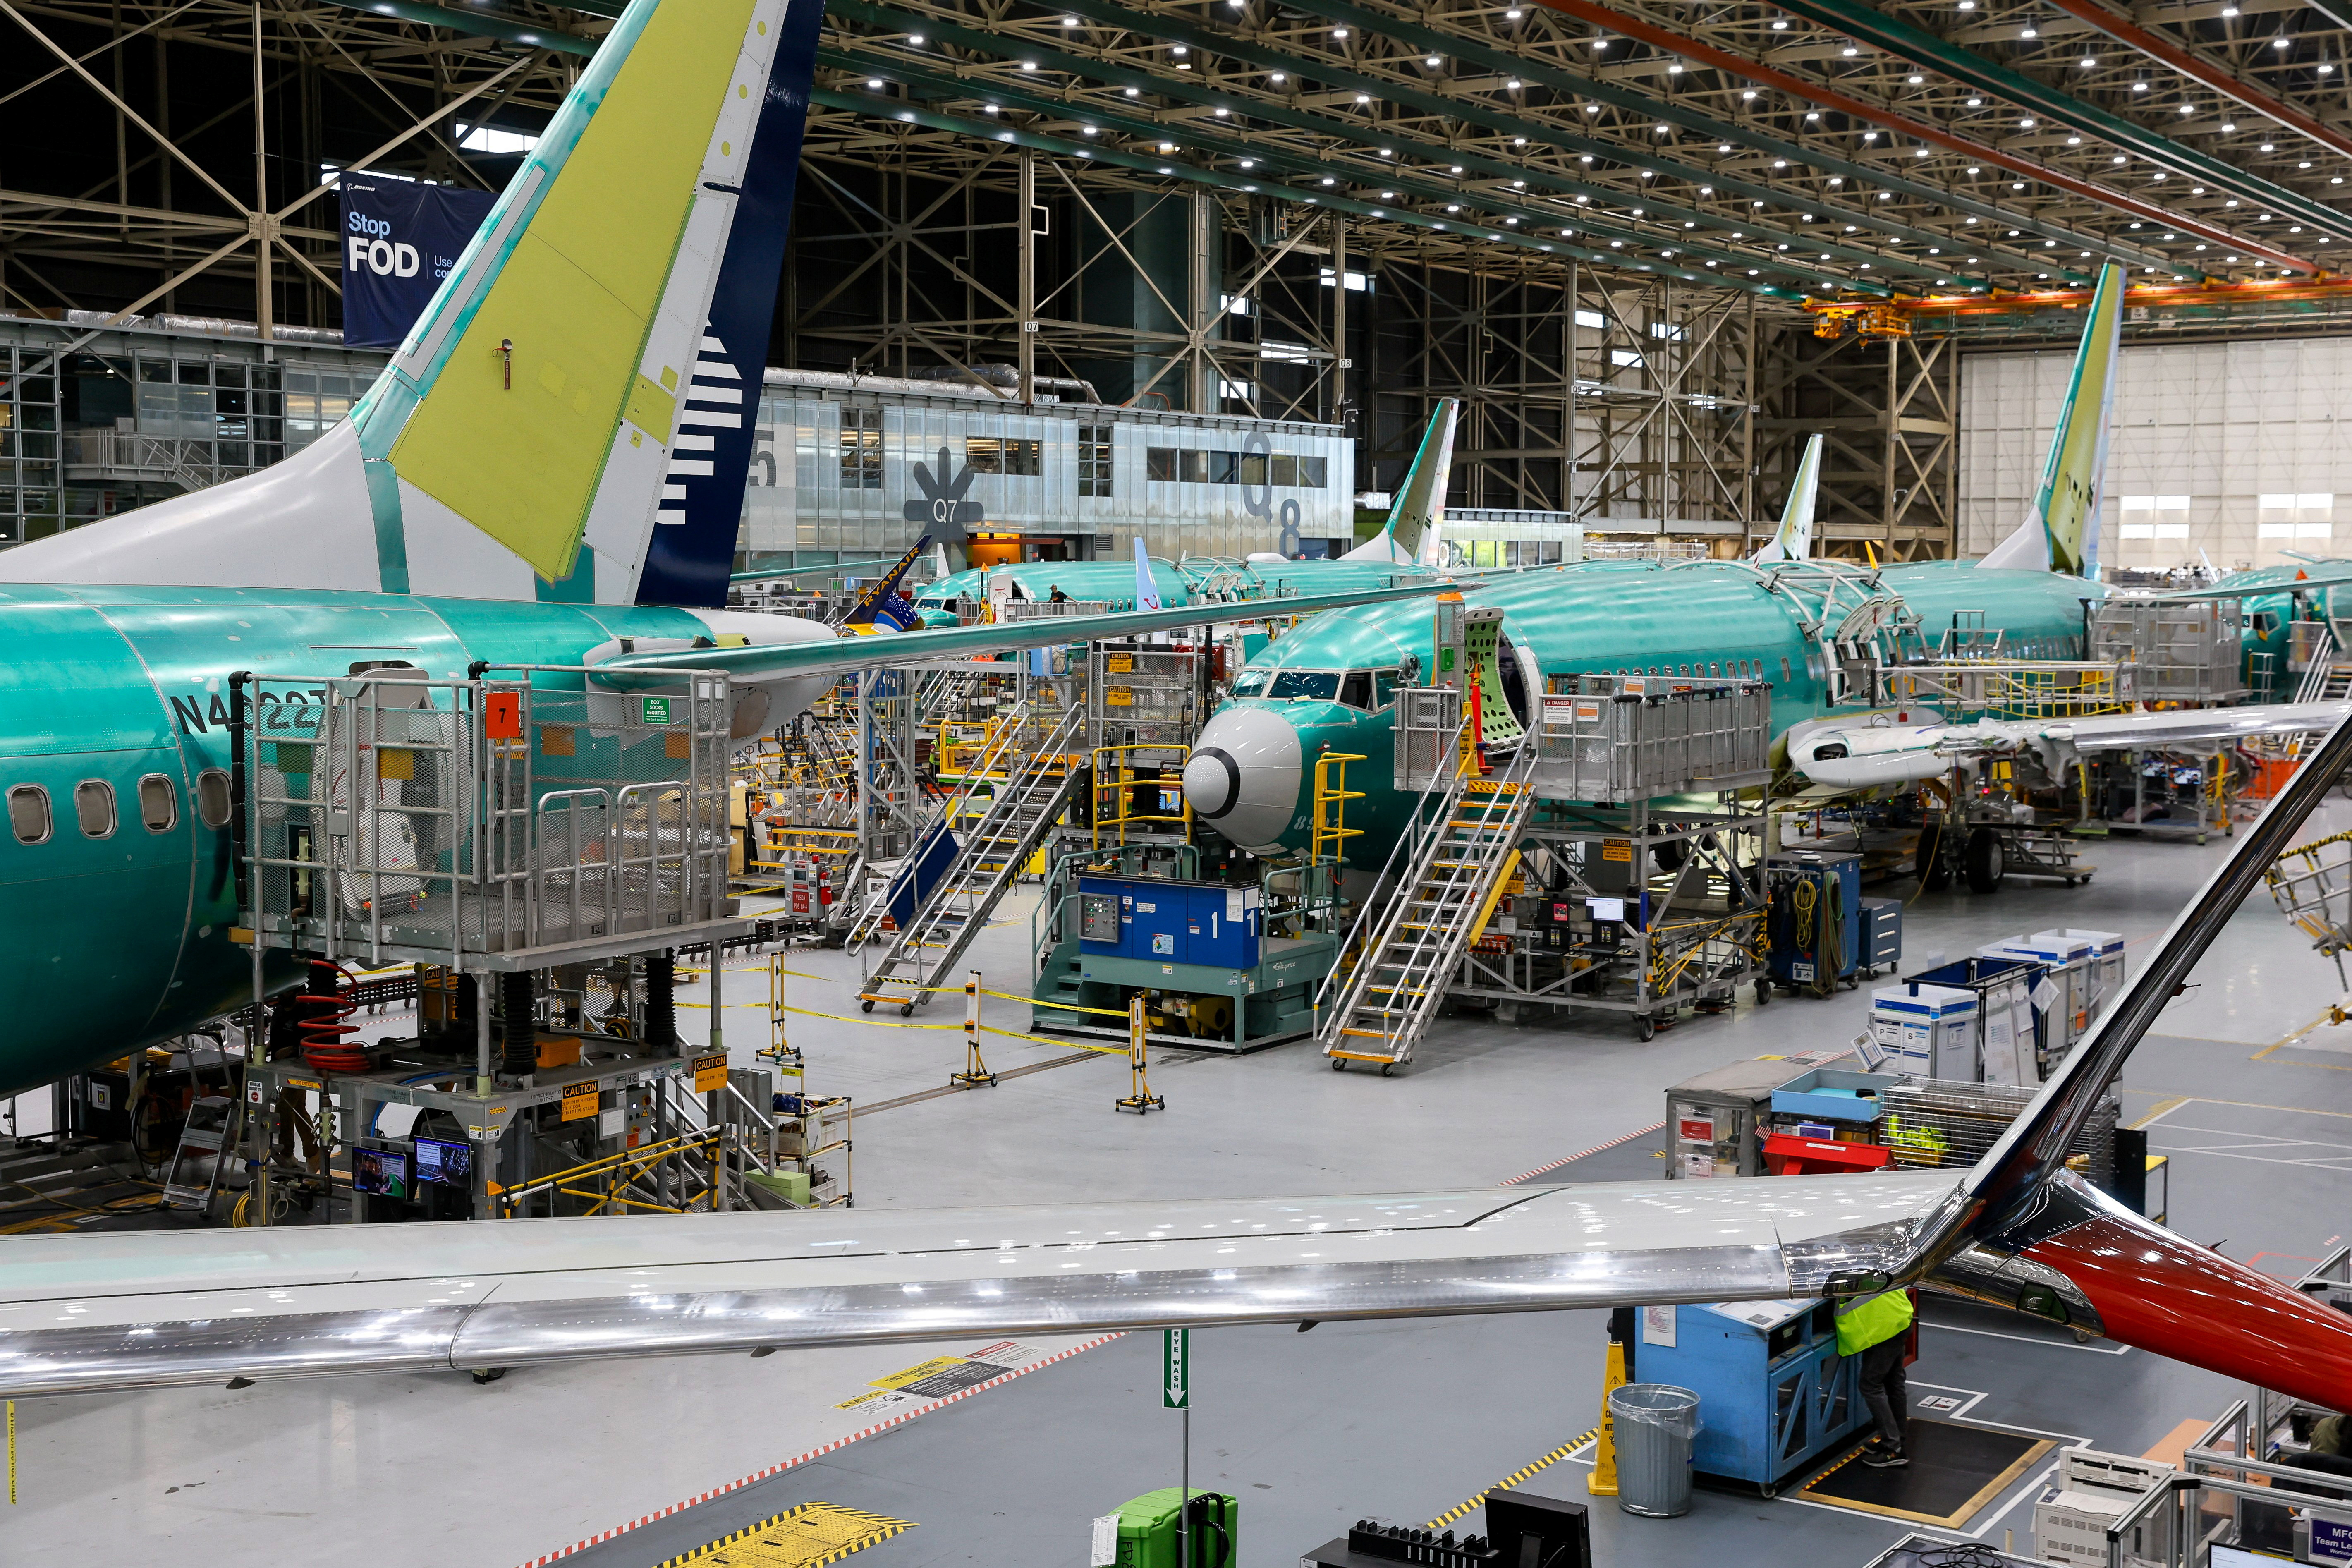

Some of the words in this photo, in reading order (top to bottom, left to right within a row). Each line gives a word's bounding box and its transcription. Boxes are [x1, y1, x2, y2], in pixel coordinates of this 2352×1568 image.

[349, 211, 390, 239] Stop
[349, 236, 419, 278] FOD
[435, 255, 452, 267] Use
[749, 429, 776, 487] 5
[1243, 431, 1273, 524] Q
[933, 498, 957, 524] Q7
[864, 546, 919, 608] RYANAIR
[499, 708, 506, 723] 7
[1212, 912, 1218, 938] 1
[1247, 909, 1254, 937] 1
[426, 969, 454, 979] CAUON
[697, 1056, 725, 1070] CAUTION
[565, 1082, 596, 1097] CAUTION
[978, 1343, 1011, 1354] DANGER
[898, 1361, 944, 1376] AWARENESS
[912, 1369, 937, 1377] AREA
[910, 1378, 947, 1391] PERSONNEL
[846, 1391, 885, 1405] CAUTION
[2315, 1537, 2338, 1547] Team
